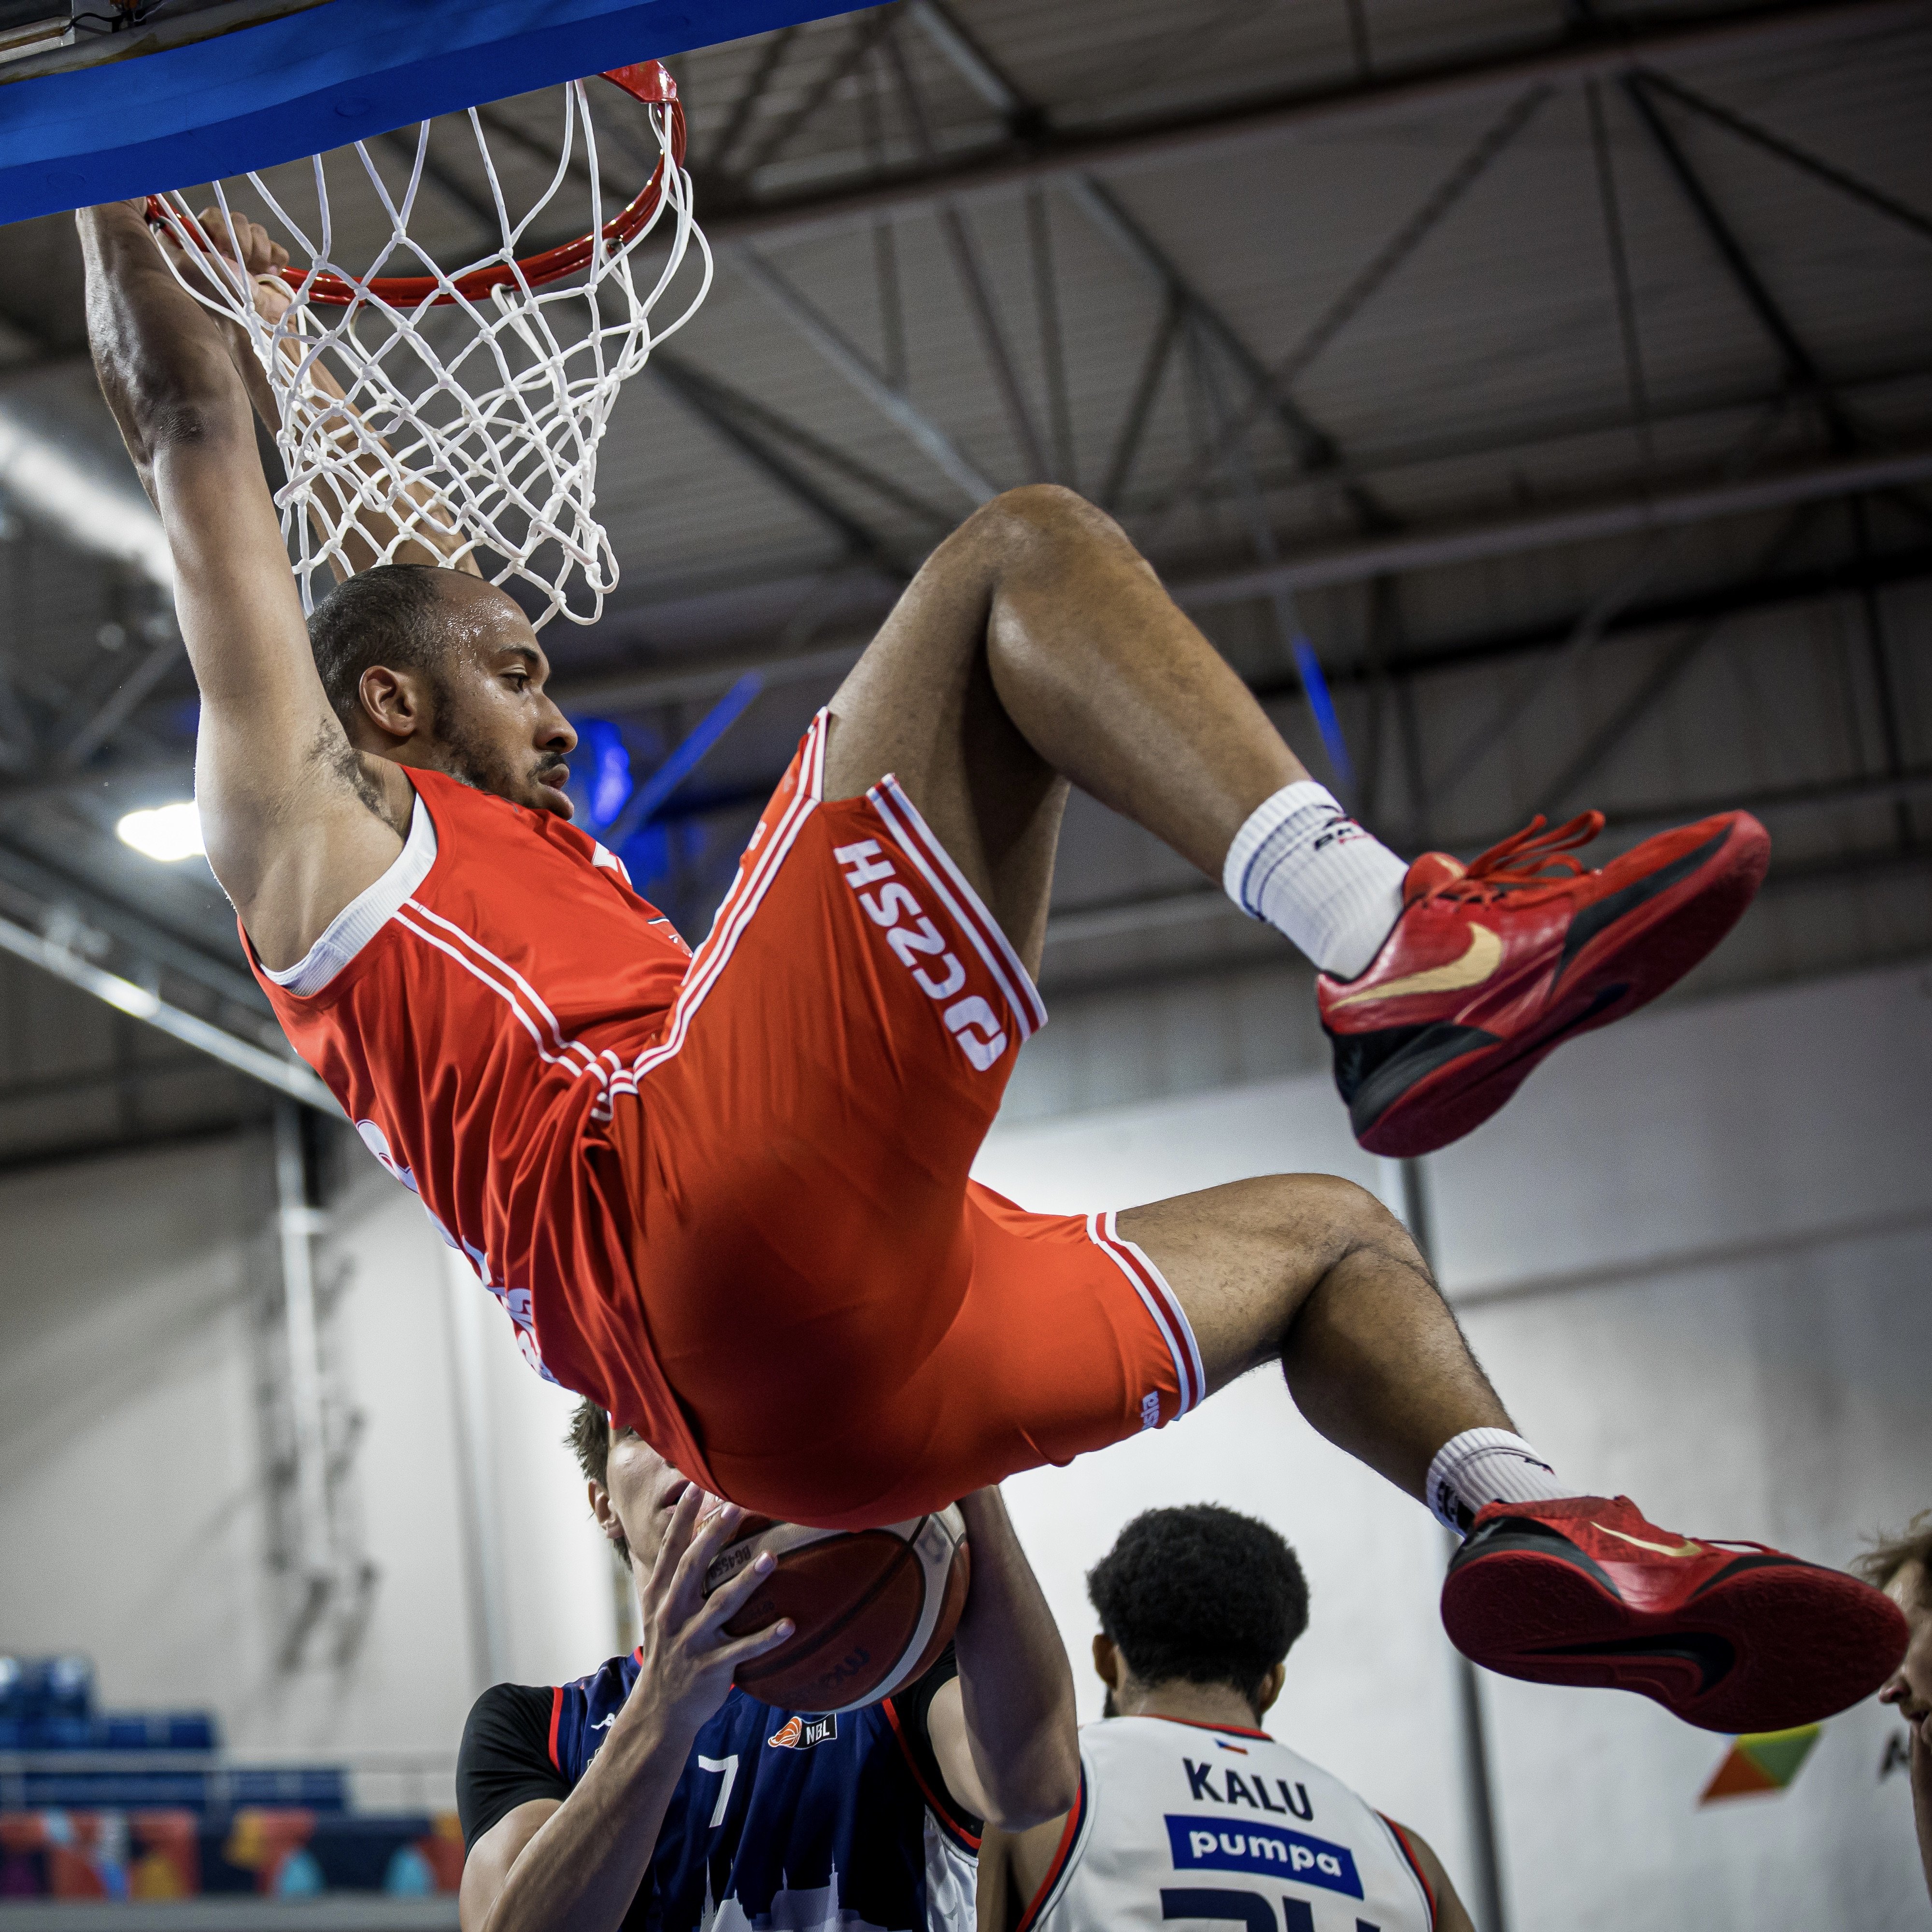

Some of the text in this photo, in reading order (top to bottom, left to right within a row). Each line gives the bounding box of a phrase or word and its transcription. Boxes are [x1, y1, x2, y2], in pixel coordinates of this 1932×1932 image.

[833, 839, 966, 1000] CZSH
[806, 1719, 830, 1745] NBL
[698, 1754, 739, 1828] 7
[1183, 1758, 1313, 1821] KALU
[1189, 1831, 1342, 1877] pumpa
